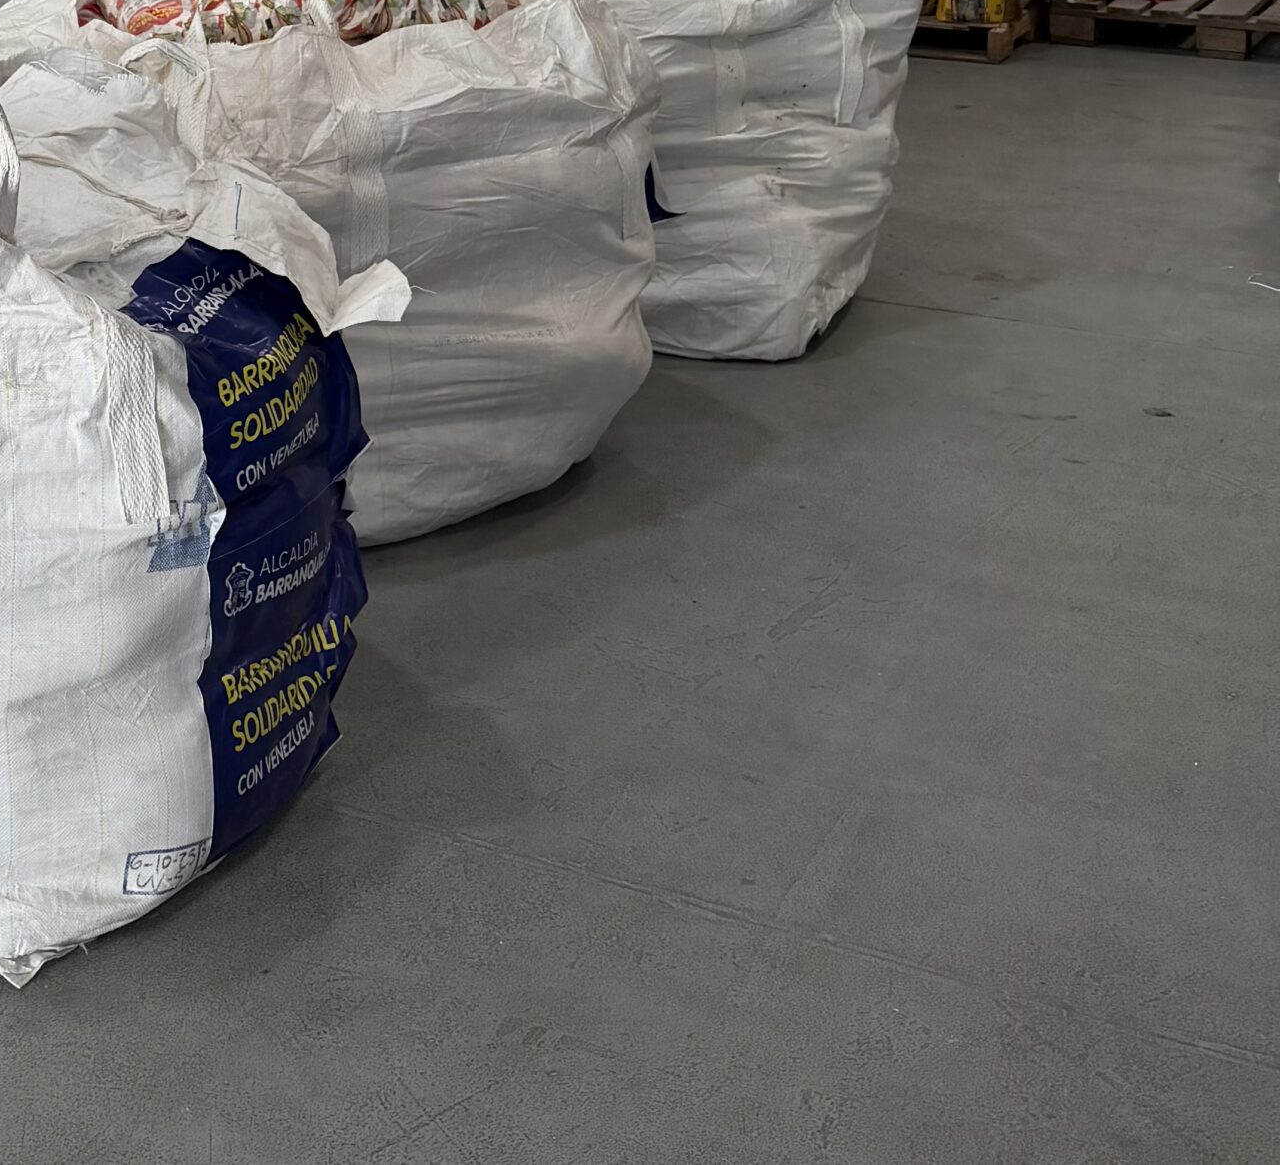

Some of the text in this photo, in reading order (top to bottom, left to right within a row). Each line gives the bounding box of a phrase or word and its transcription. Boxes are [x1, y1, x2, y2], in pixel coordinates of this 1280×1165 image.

[236, 457, 267, 491] CON
[237, 711, 315, 796] CON VENEZUELA
